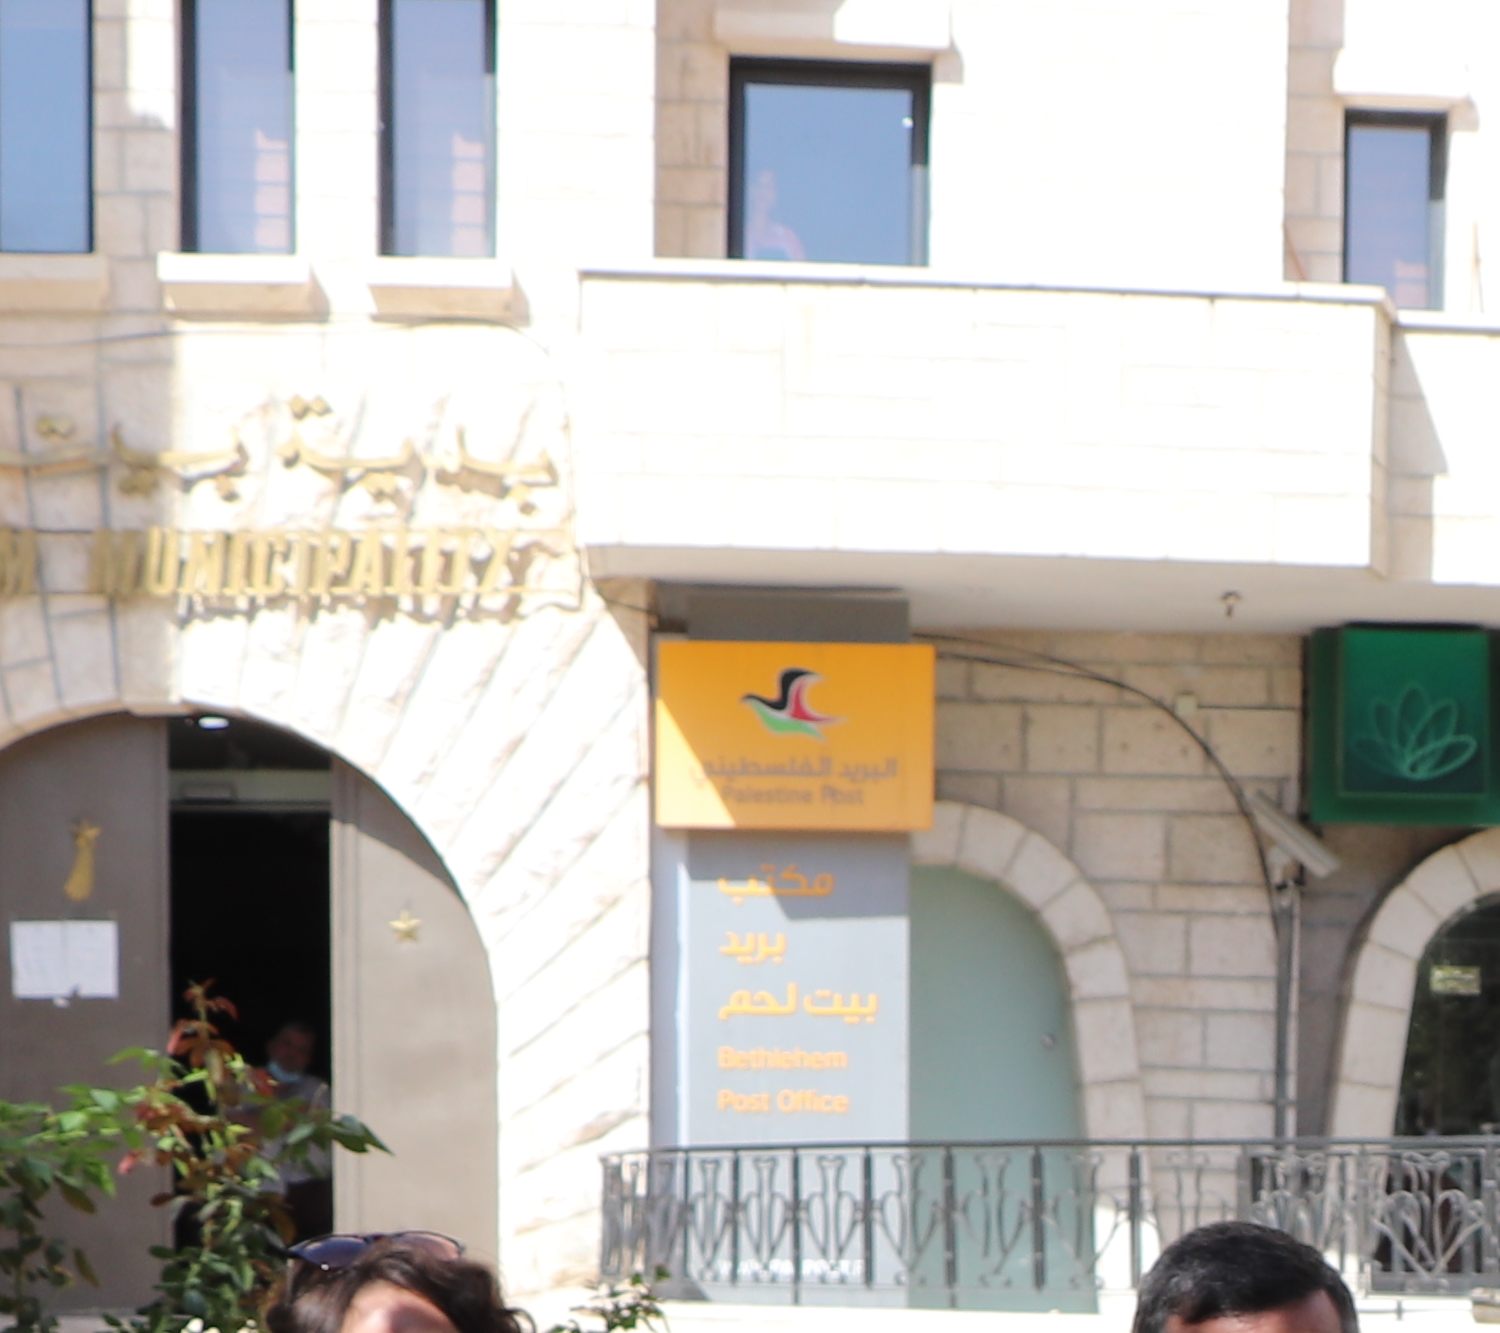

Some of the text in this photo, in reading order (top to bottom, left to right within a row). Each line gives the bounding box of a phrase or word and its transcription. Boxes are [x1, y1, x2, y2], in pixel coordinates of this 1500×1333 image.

[88, 525, 518, 598] MUNICIPALITY
[838, 756, 898, 783] البريد
[720, 784, 814, 804] Palestine
[717, 863, 835, 906] مكتب
[718, 931, 787, 965] بريد
[718, 982, 879, 1024] بيت لحم
[717, 1046, 849, 1070] Bethlehem
[716, 1088, 850, 1114] Post Office
